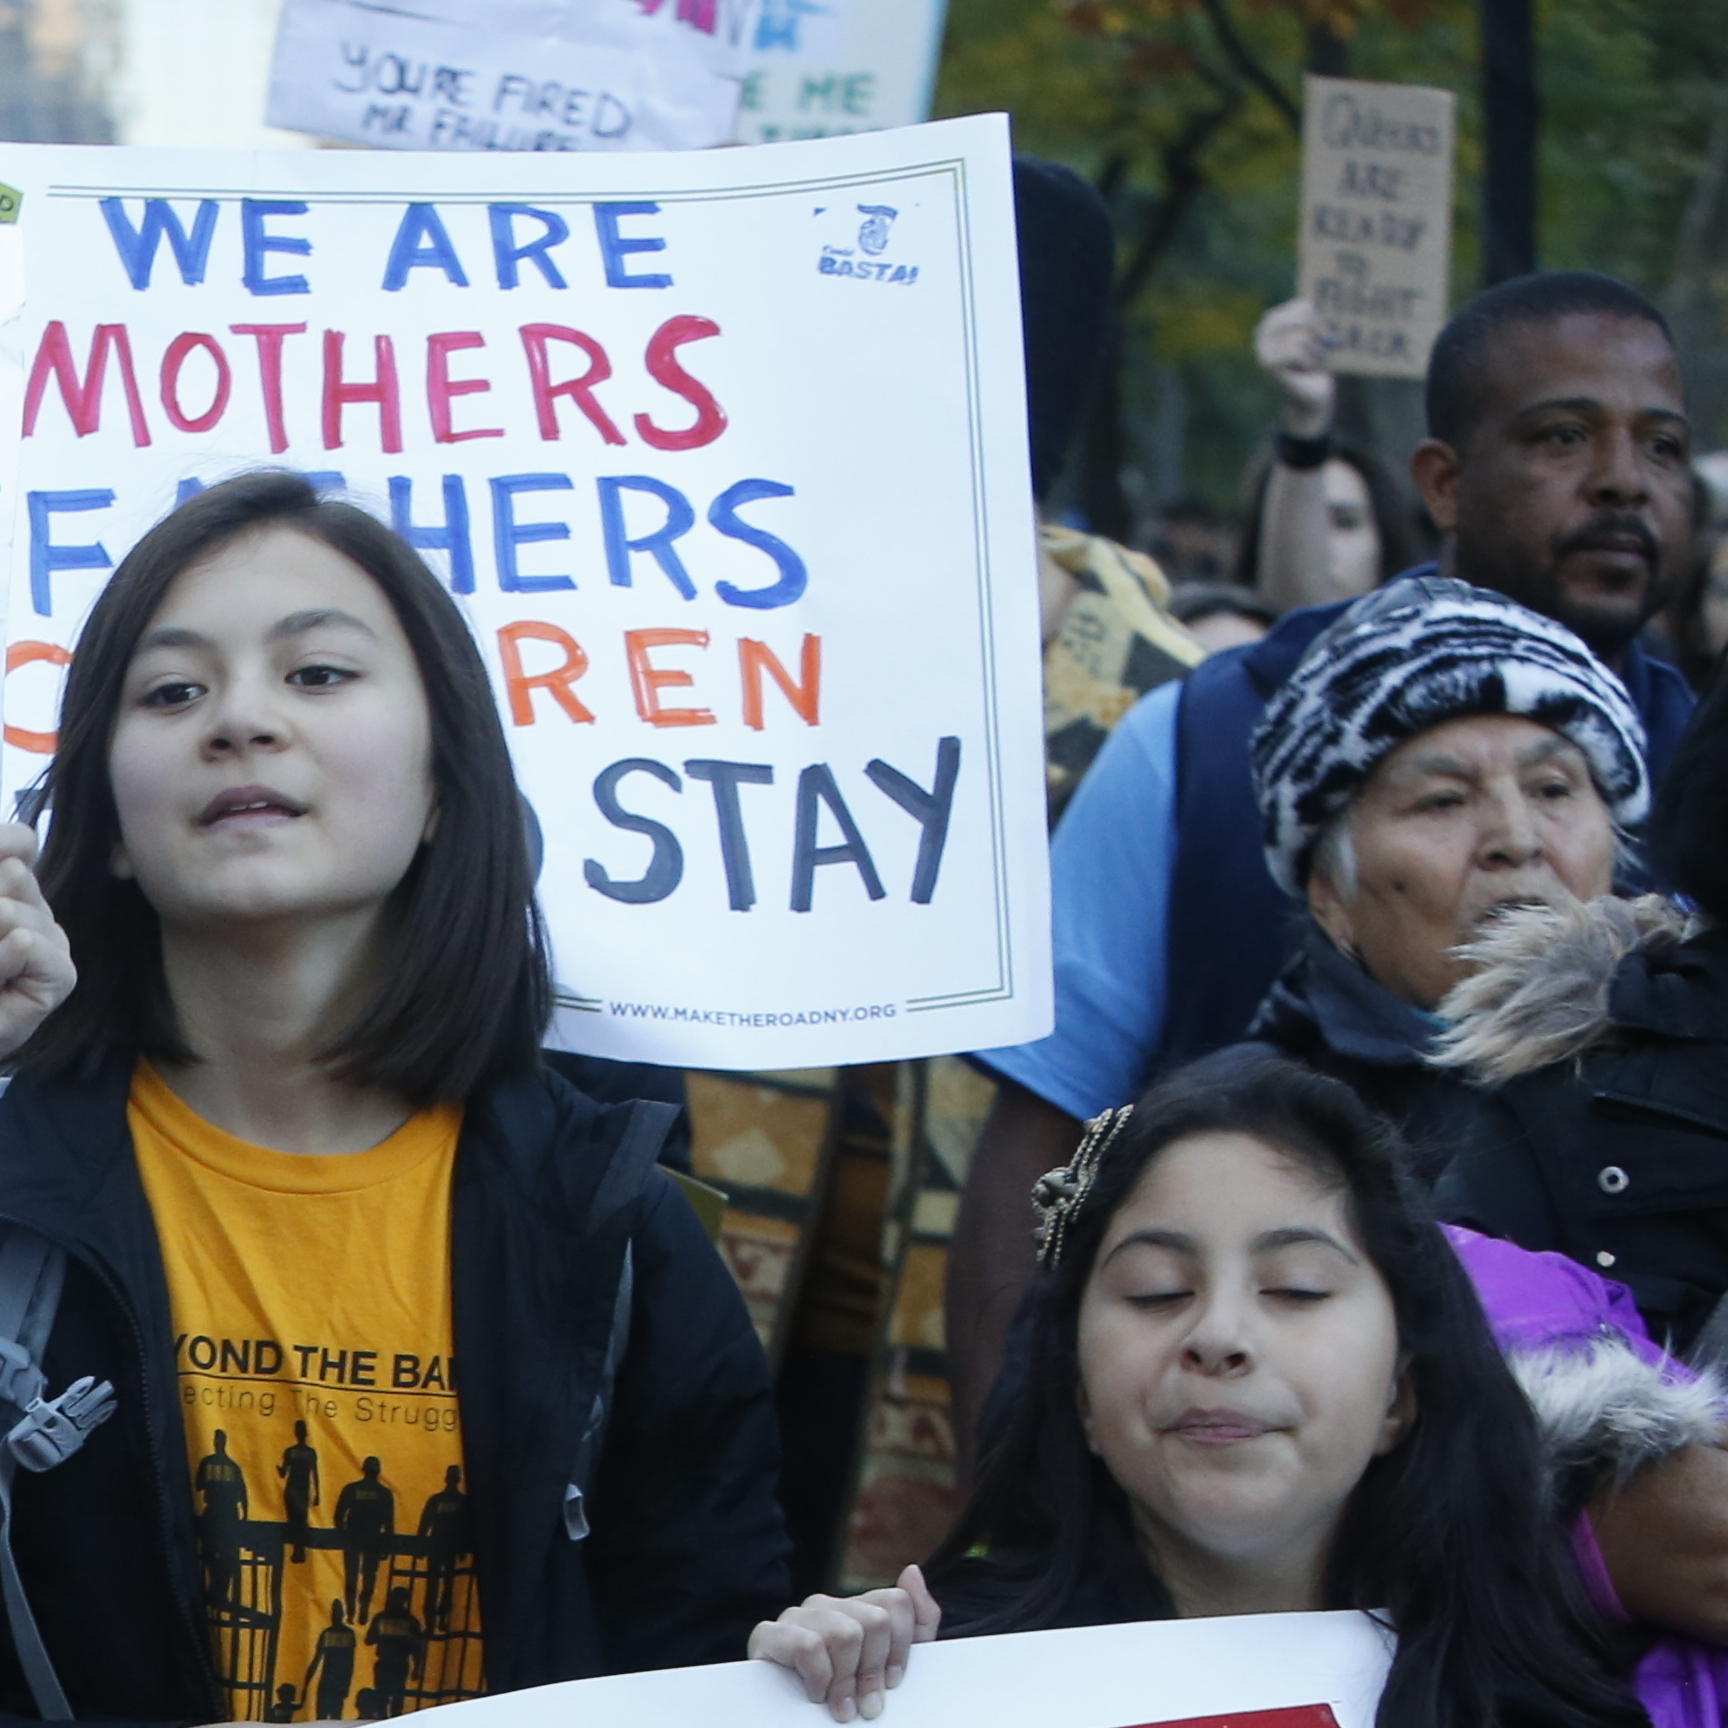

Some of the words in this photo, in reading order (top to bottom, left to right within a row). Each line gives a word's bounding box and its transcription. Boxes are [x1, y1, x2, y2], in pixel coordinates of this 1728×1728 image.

[100, 197, 312, 296] WE
[381, 201, 674, 293] ARE
[21, 314, 728, 455] MOTHERS
[26, 472, 809, 616] FHERS
[583, 736, 961, 912] STAY
[609, 1001, 897, 1028] WWW.MAKETHEROADNY.ORG
[289, 1389, 338, 1418] The
[293, 1344, 378, 1385] THE
[393, 1354, 457, 1390] BA
